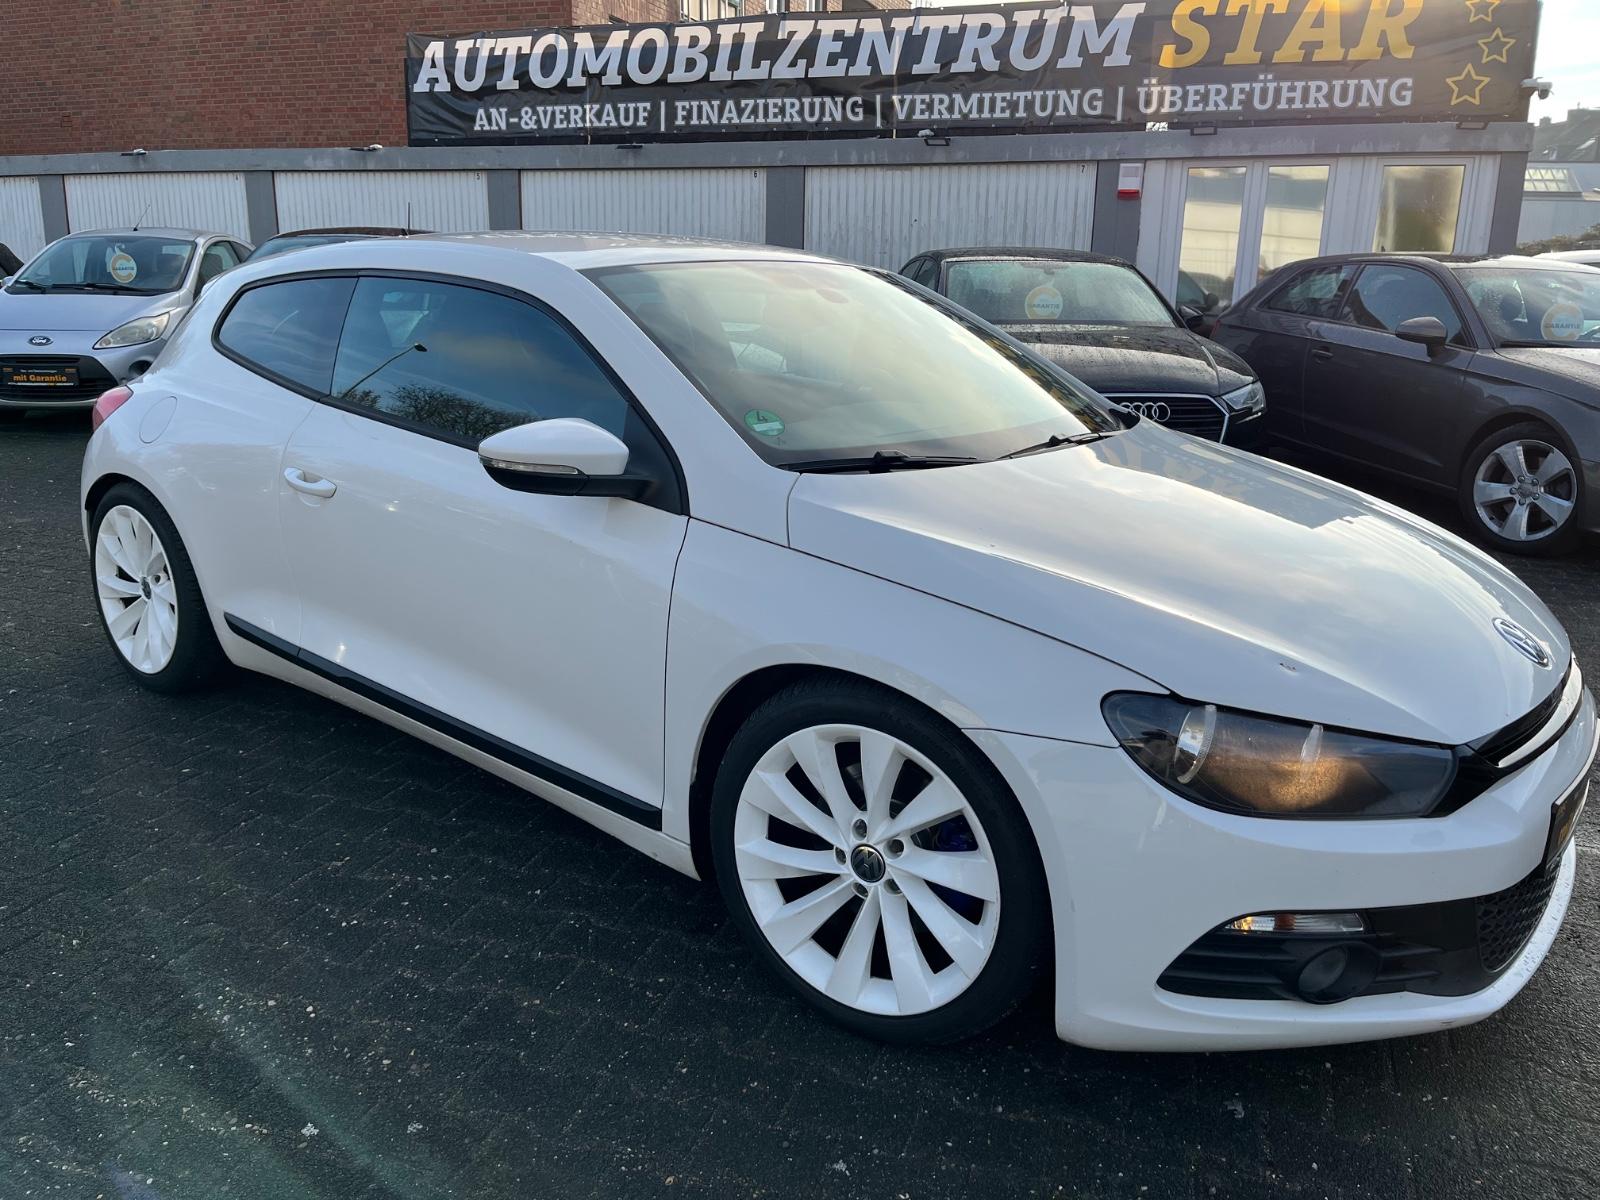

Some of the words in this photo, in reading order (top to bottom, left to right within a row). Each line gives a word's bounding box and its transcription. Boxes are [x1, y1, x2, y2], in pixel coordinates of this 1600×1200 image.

[413, 3, 1146, 93] AUTOMOBILZENTRUM
[1158, 0, 1424, 69] STAR
[473, 102, 652, 131] AN-&VERKAUF
[674, 97, 864, 126] FINAZIERUNG
[892, 88, 1104, 121] VERMIETUNG
[1136, 74, 1414, 114] ÜBERFÜHRUNG
[13, 374, 27, 382] mit
[29, 374, 68, 382] Garantie
